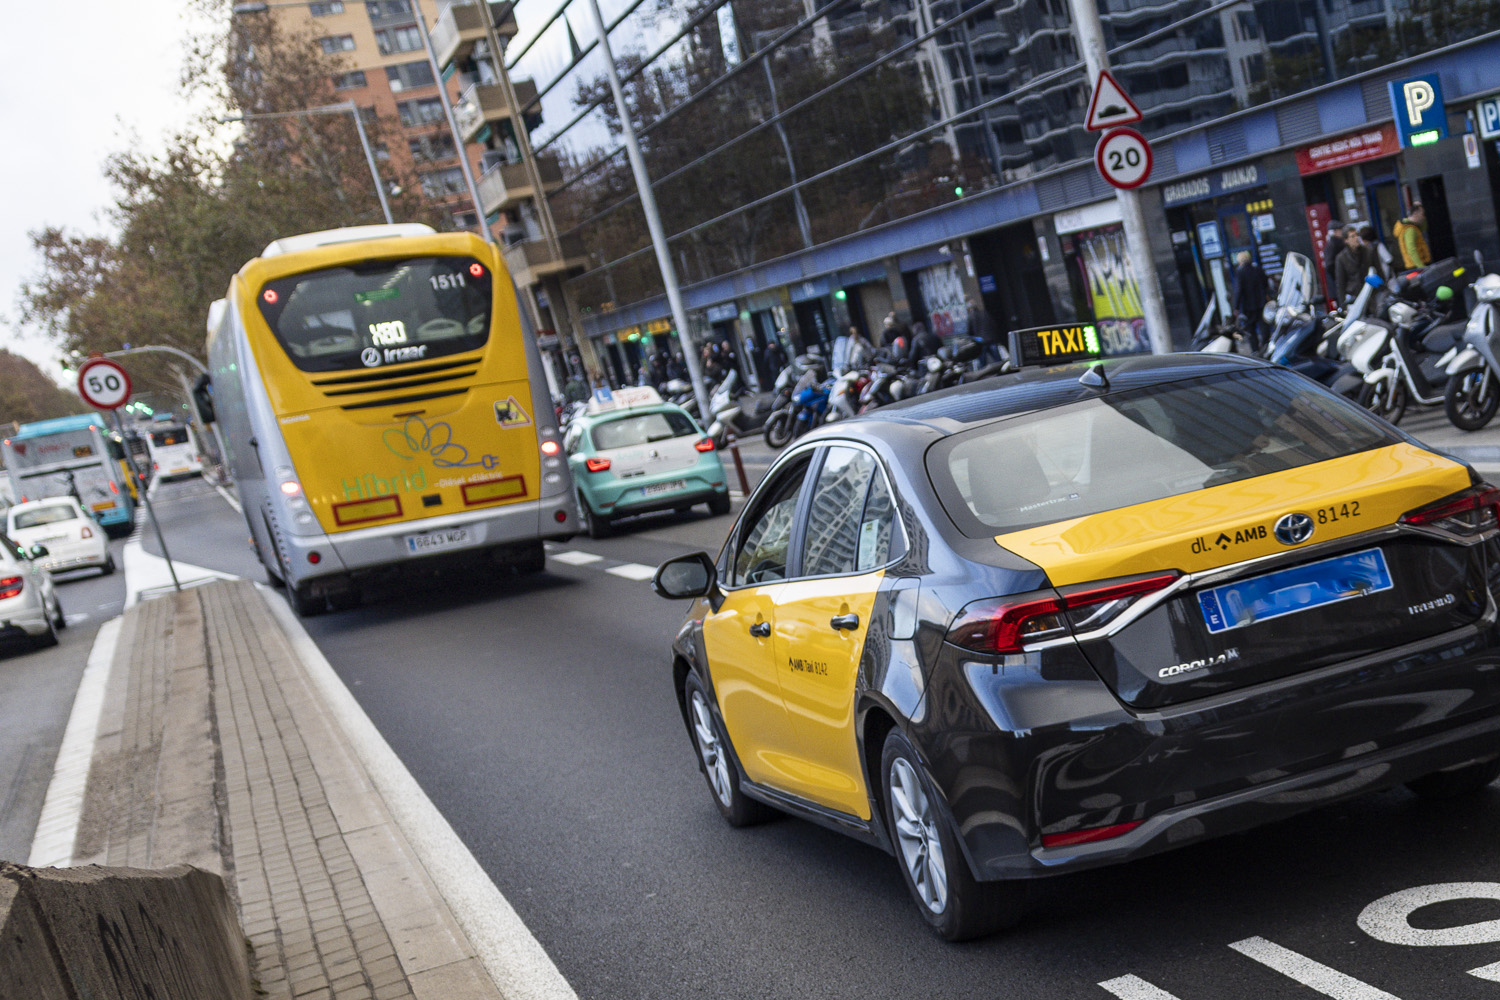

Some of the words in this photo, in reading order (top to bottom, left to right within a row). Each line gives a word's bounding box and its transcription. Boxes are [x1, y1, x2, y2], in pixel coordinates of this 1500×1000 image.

[1403, 80, 1436, 127] P
[1108, 147, 1141, 170] 20
[1221, 165, 1258, 190] JUANJO
[428, 272, 467, 291] 1511
[1037, 327, 1085, 356] TAXI
[88, 374, 120, 394] 50
[597, 390, 610, 402] L
[342, 465, 428, 502] Híbrid
[1191, 536, 1212, 555] dl.
[1234, 525, 1268, 546] AMB
[1317, 501, 1361, 525] 8142
[1210, 614, 1220, 625] E
[814, 661, 828, 676] 8142
[1158, 654, 1227, 678] COROLLA
